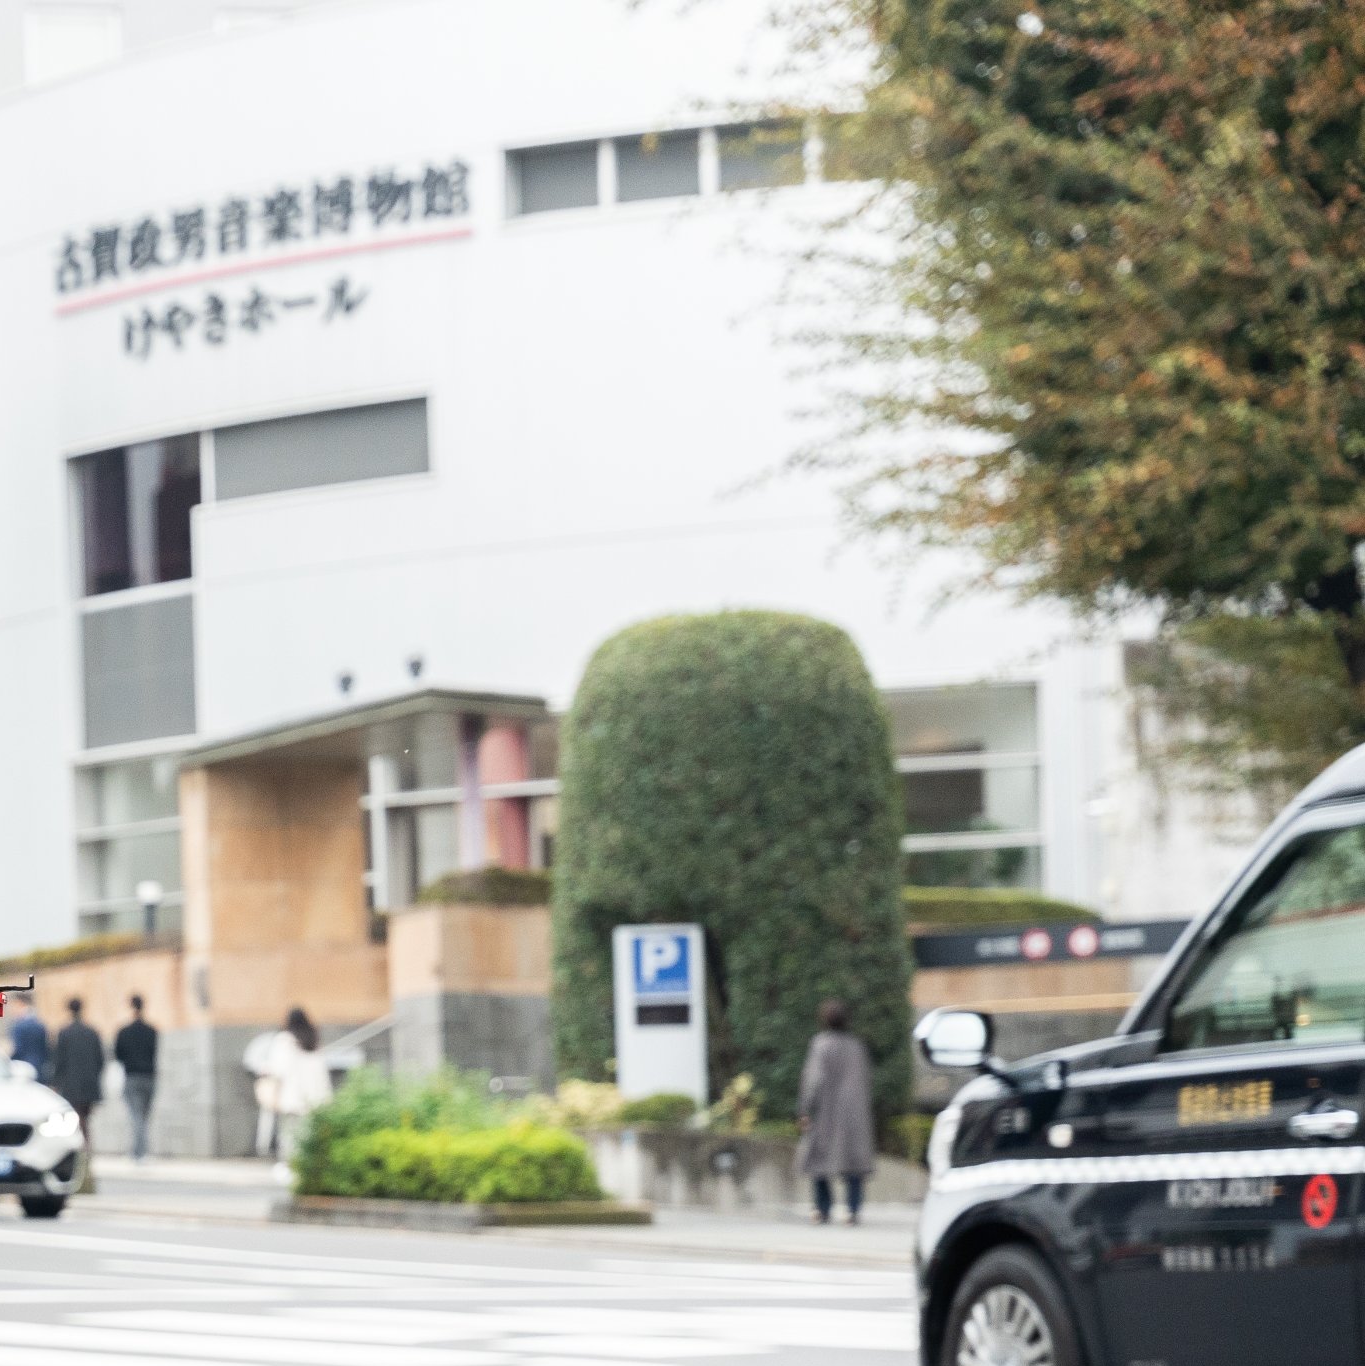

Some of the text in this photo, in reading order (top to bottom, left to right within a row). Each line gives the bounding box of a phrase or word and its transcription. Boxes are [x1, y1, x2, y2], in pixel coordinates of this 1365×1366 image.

[55, 160, 471, 294] 古賀政男音楽博物館
[122, 275, 369, 362] けやきホール
[640, 936, 681, 983] P
